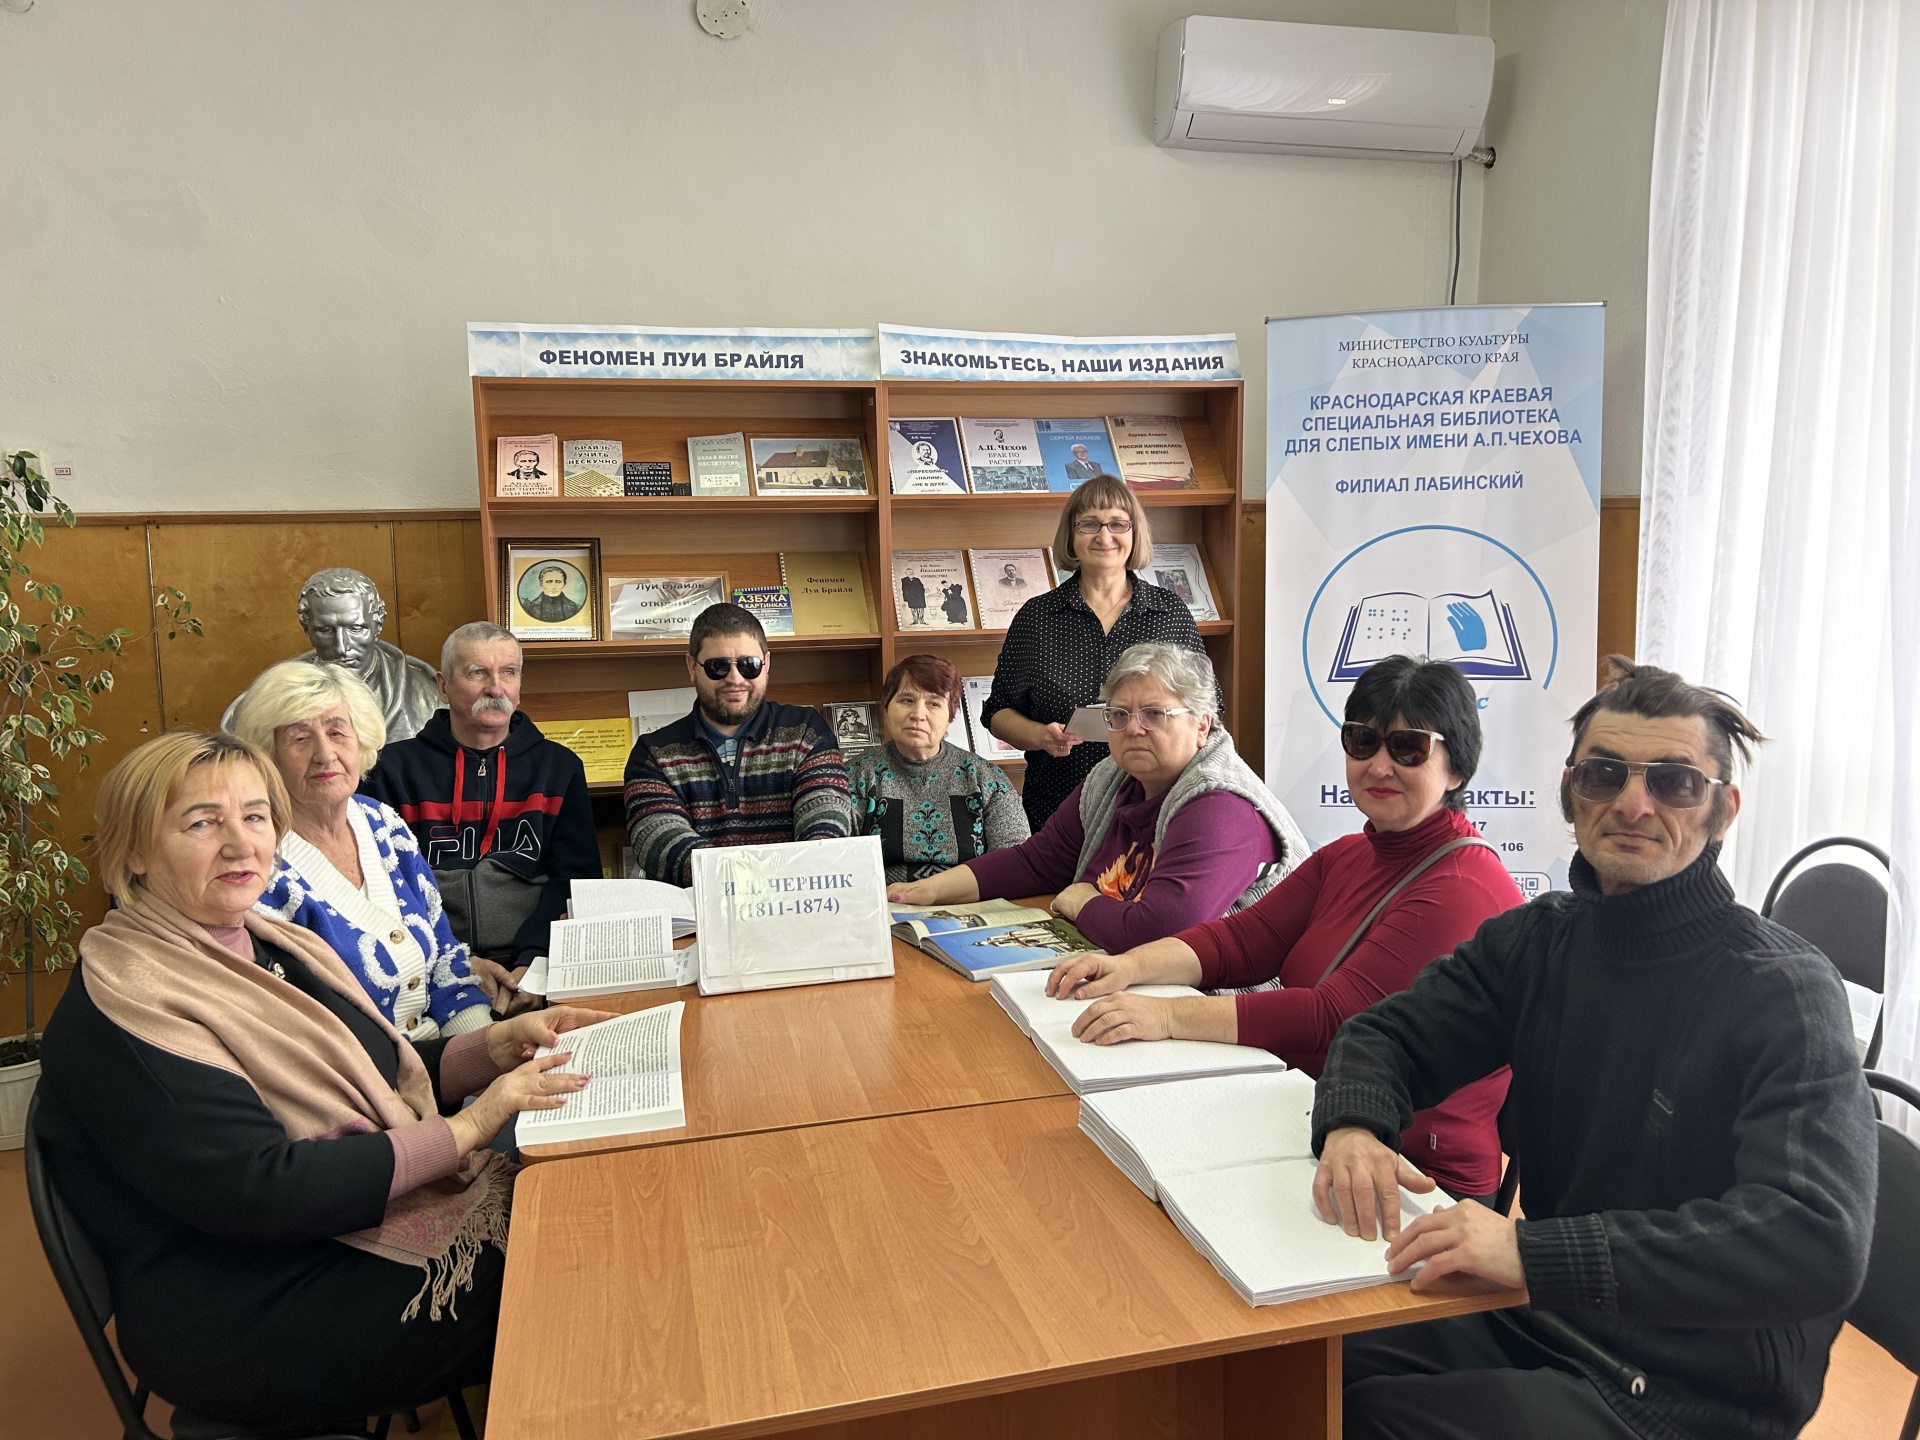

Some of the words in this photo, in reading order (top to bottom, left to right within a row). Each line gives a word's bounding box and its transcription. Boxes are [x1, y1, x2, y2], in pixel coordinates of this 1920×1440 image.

[1338, 336, 1456, 352] МИНИСТЕРСТВО
[1458, 333, 1530, 348] КУЛЬТУРЫ
[538, 349, 656, 367] ФЕНОМЕН
[661, 351, 707, 367] ЛУИ
[713, 350, 805, 369] БРАЙЛЯ
[899, 349, 1057, 374] ЗНАКОМЬТЕСЬ,
[1061, 358, 1123, 373] НАШИ
[1127, 355, 1225, 374] ИЗДАНИЯ
[1351, 354, 1482, 370] КРАСНОДАРСКОГО
[1484, 351, 1520, 364] КРАЯ
[1309, 390, 1464, 411] КРАСНОДАРСКАЯ
[1469, 386, 1554, 405] КРАЕВАЯ
[1301, 412, 1435, 434] СПЕЦИАЛЬНАЯ
[1439, 408, 1561, 427] БИБЛИОТЕКА
[1284, 438, 1321, 456] ДЛЯ
[1325, 434, 1401, 453] СЛЕПЫХ
[1406, 432, 1469, 450] ИМЕНИ
[1473, 428, 1583, 448] А.П.ЧЕХОВА
[1335, 476, 1410, 494] ФИЛИАЛ
[1414, 470, 1524, 492] ЛАБИНСКИЙ
[636, 582, 659, 592] Луи
[662, 580, 705, 591] Брайль
[802, 587, 820, 595] Луи
[821, 586, 854, 595] Брайля
[738, 594, 788, 603] АЗБУКА
[1320, 784, 1353, 804] На
[1465, 788, 1536, 806] акты:
[1500, 842, 1524, 852] 106
[767, 873, 853, 893] ЧЕРНИК
[738, 896, 840, 922] (1811-1874)
